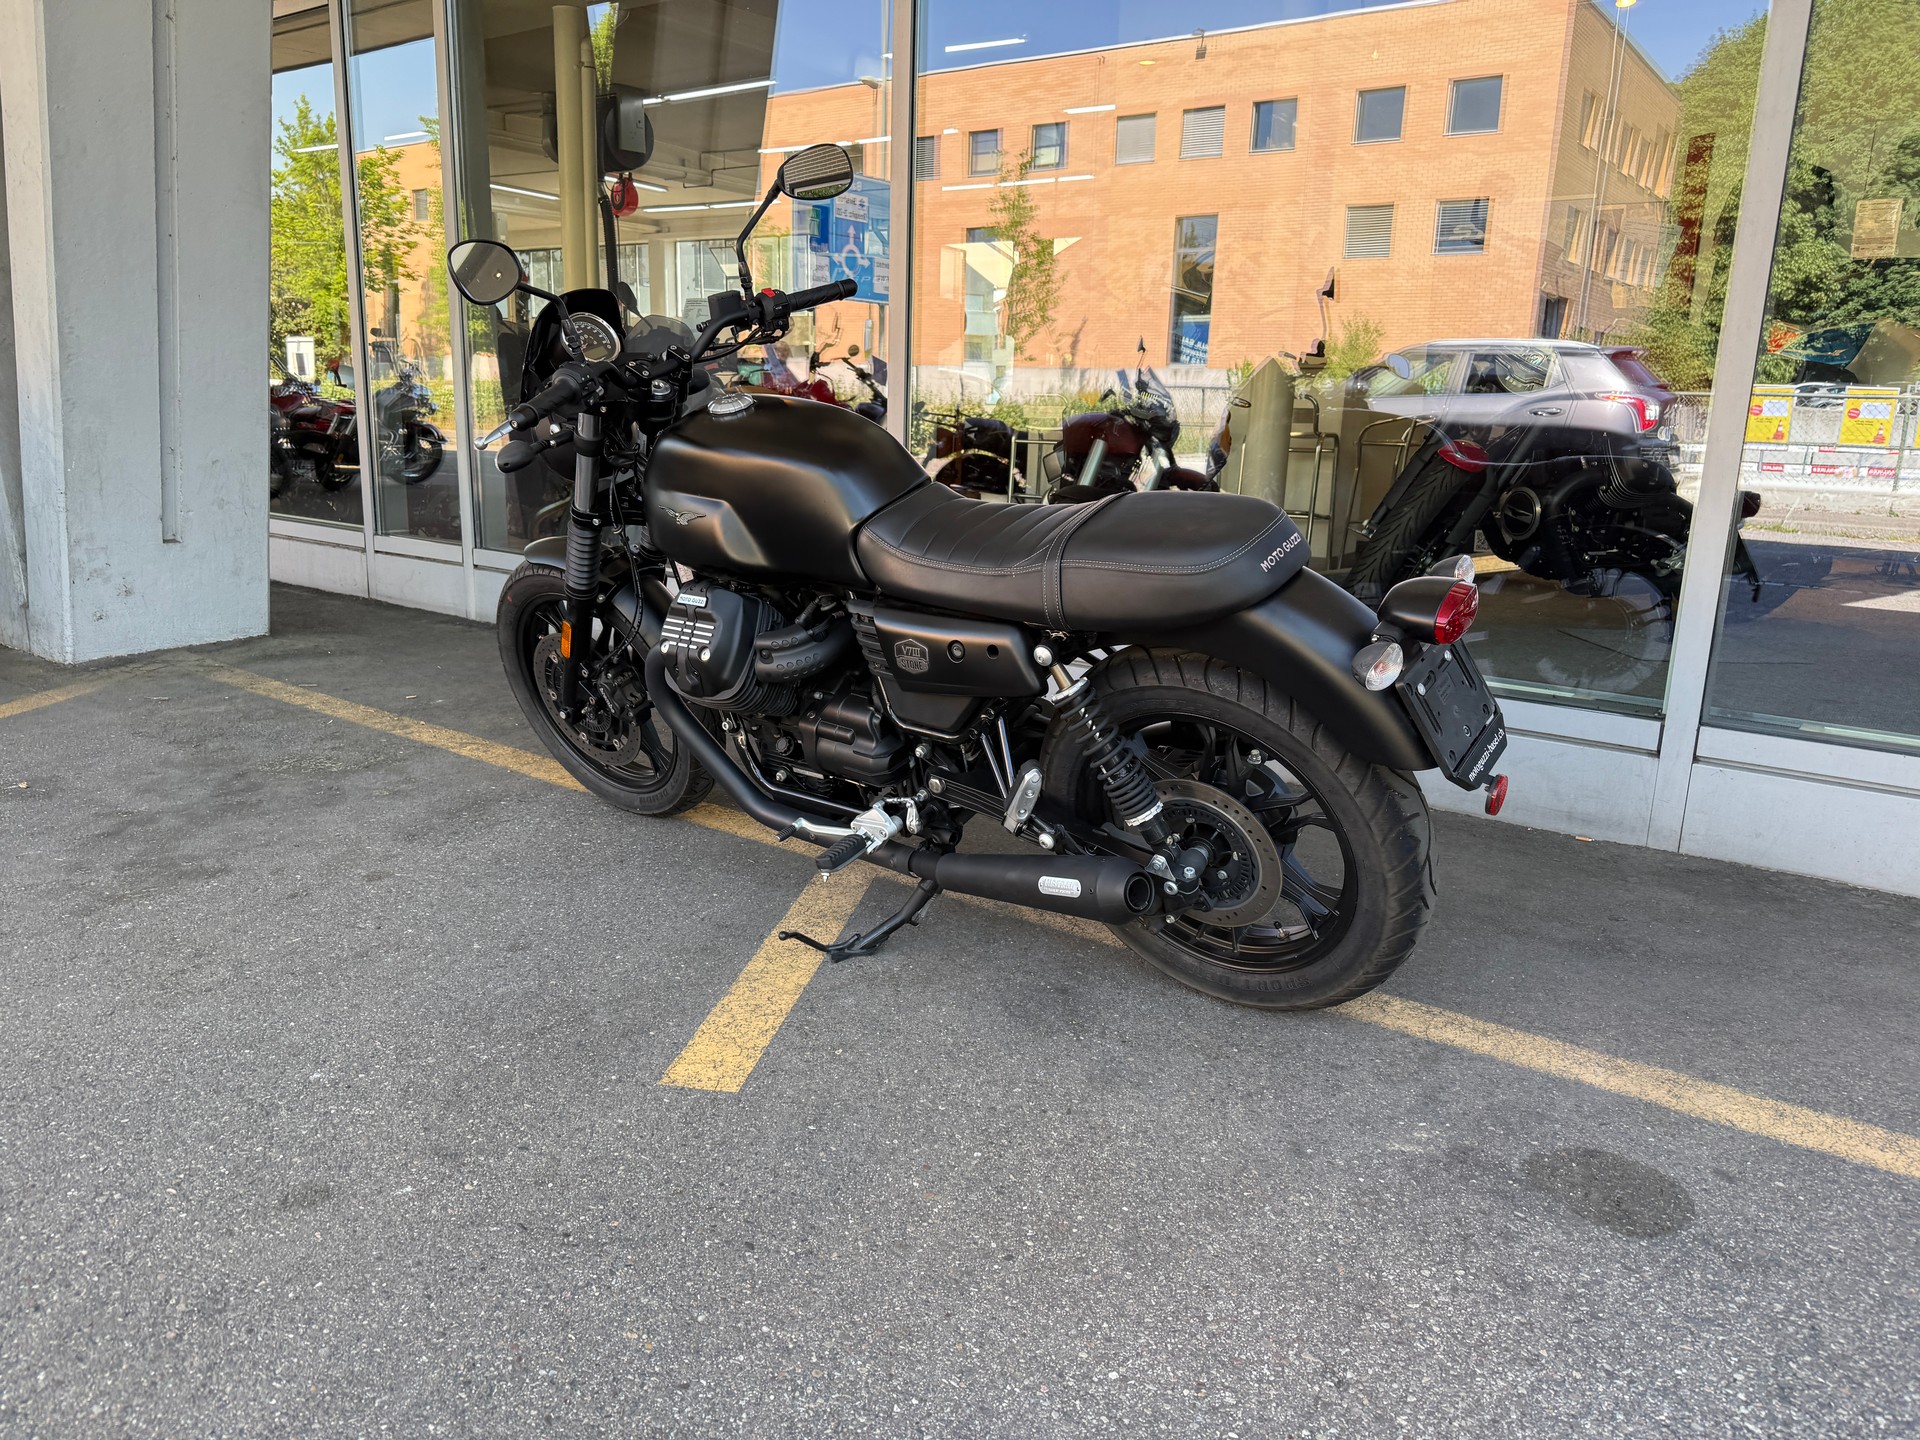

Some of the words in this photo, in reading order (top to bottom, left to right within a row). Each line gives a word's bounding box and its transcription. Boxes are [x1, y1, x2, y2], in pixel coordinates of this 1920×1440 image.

[1260, 547, 1285, 572] MOTO
[1283, 532, 1302, 552] GUZZI
[901, 659, 923, 671] STONE
[1469, 728, 1505, 781] motoguzzi-basel.ch
